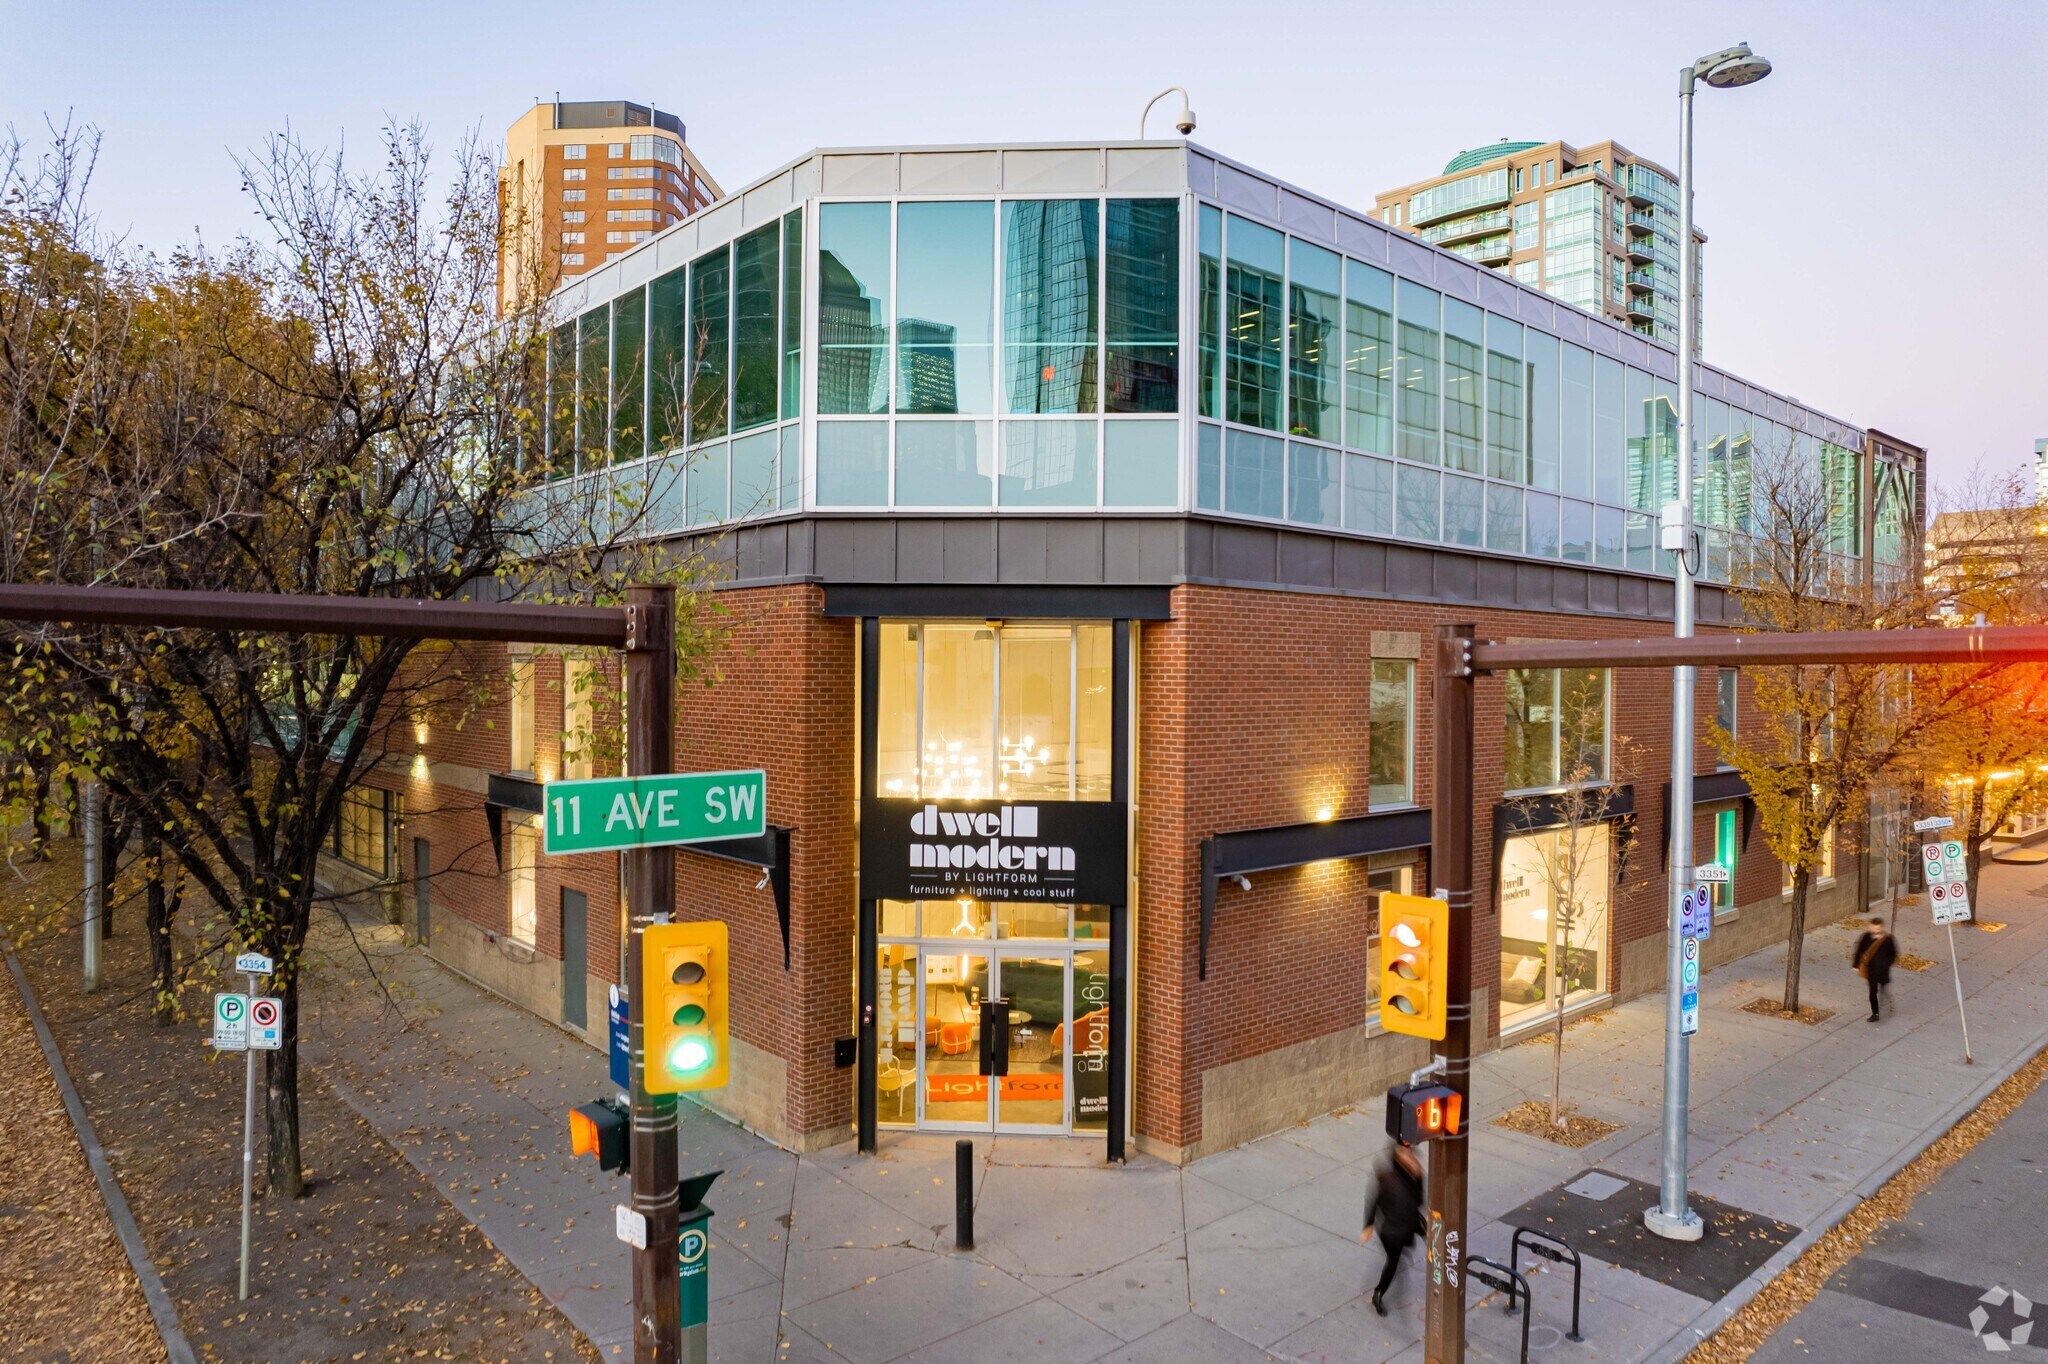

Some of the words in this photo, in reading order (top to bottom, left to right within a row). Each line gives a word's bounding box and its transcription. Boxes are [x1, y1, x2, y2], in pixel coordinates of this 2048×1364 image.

[551, 795, 580, 836] 11
[605, 789, 680, 832] AVE
[704, 784, 757, 824] SW
[910, 804, 1038, 837] dwell
[910, 838, 1076, 871] modern
[945, 872, 960, 881] BY
[965, 873, 1038, 883] LIGHTFORM
[1699, 869, 1723, 879] 3351
[910, 884, 955, 894] furniture
[969, 886, 1009, 898] lighting
[1023, 888, 1045, 897] cool
[1049, 888, 1075, 898] stuff
[242, 959, 266, 970] 3354
